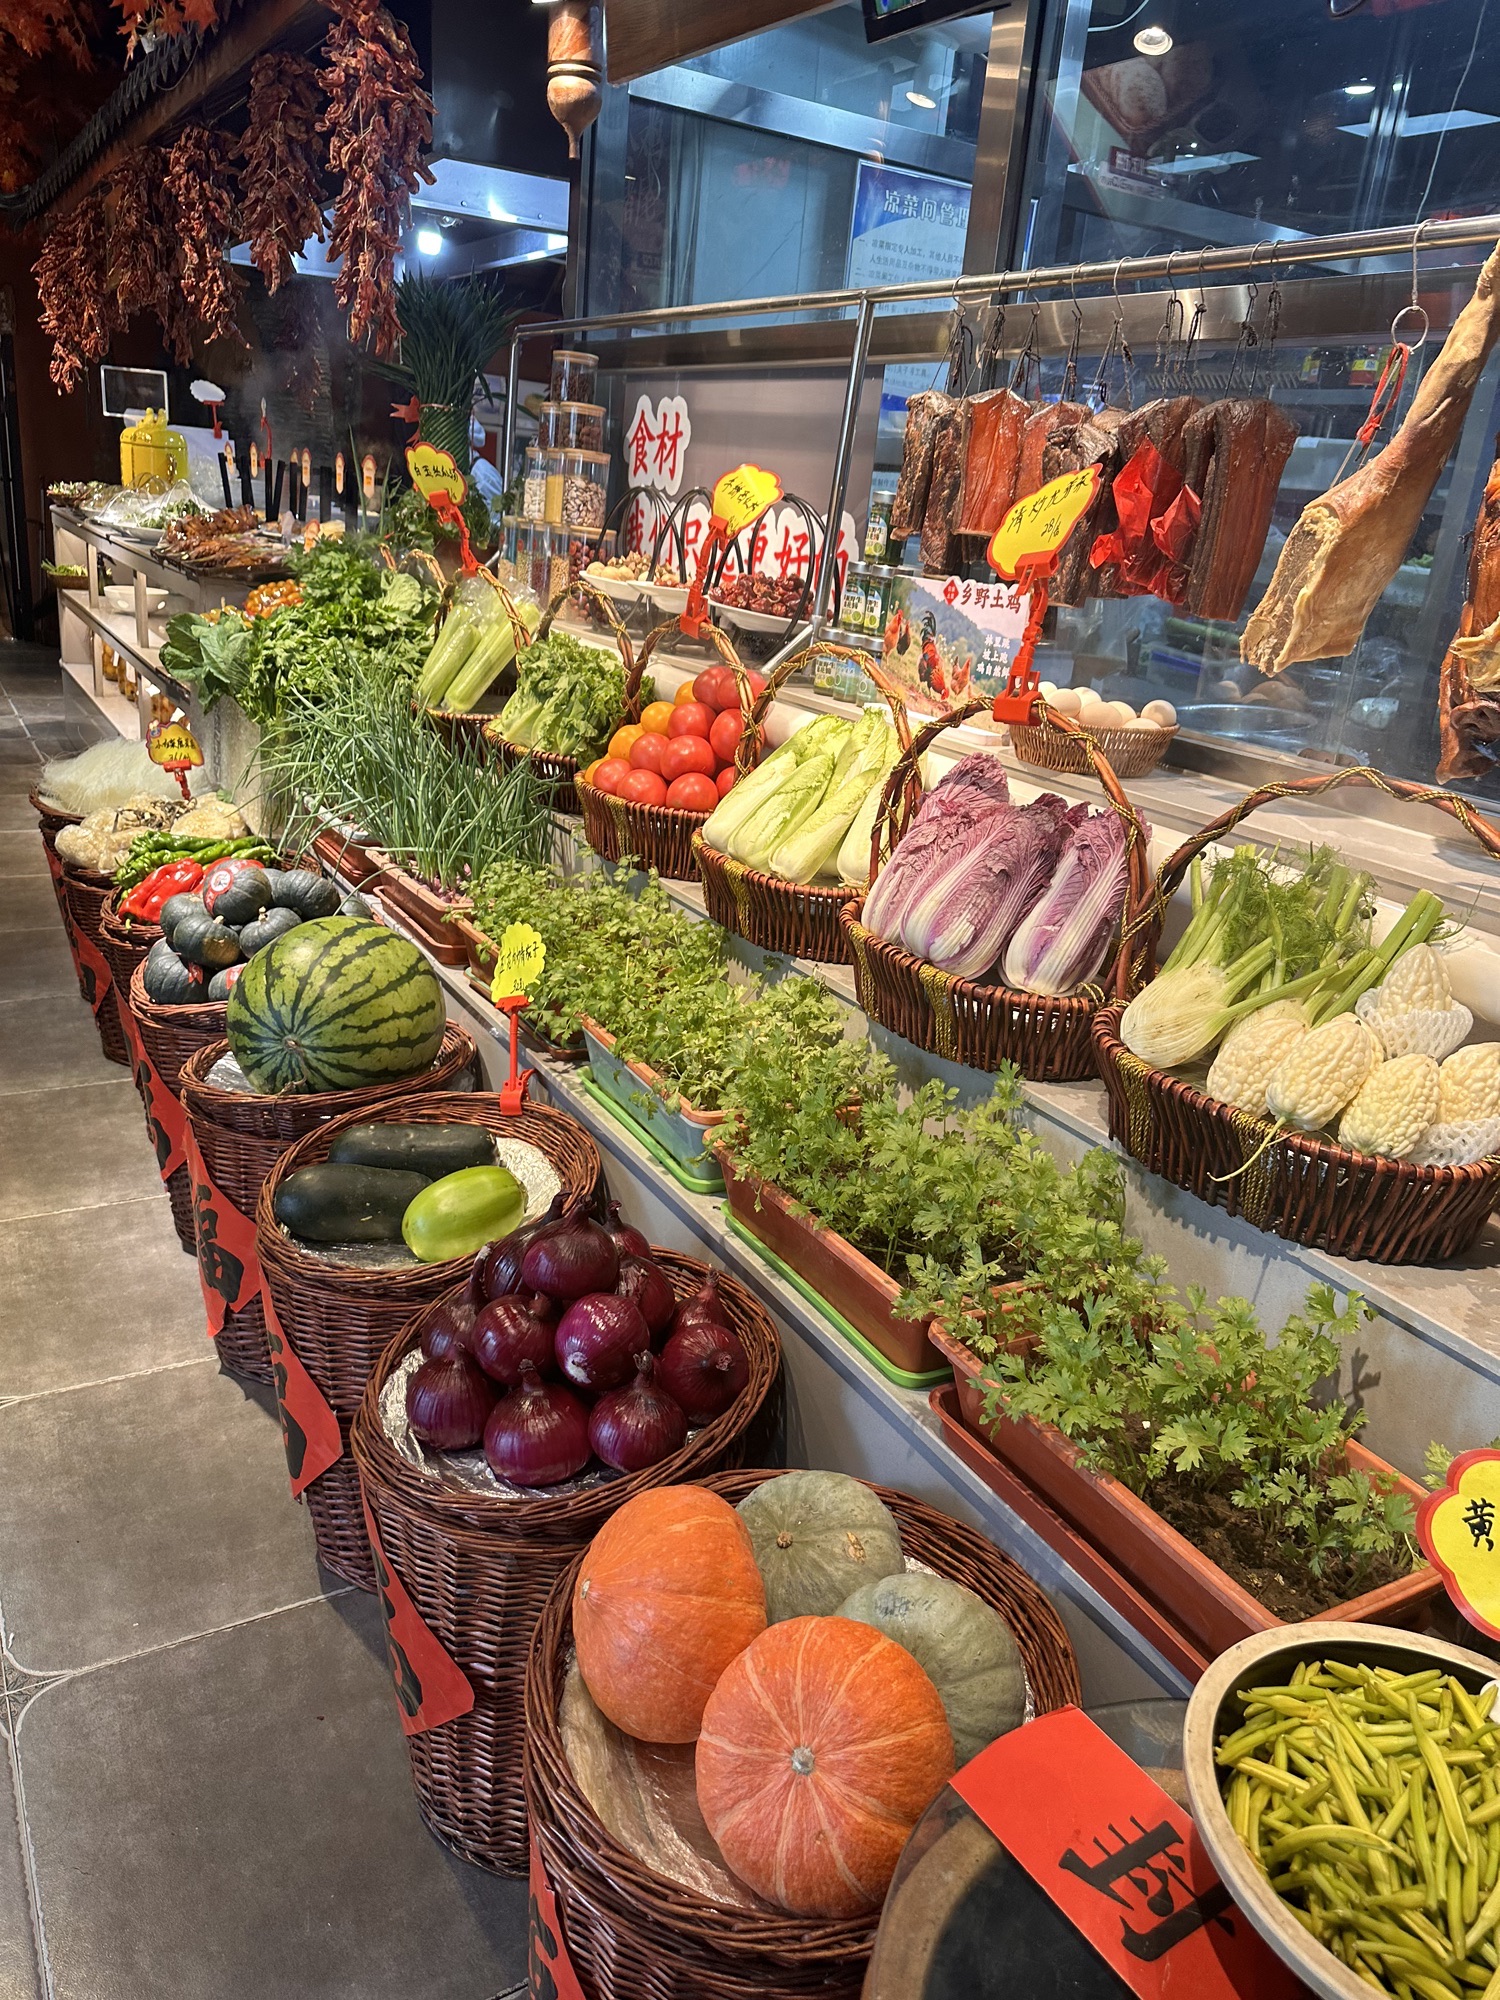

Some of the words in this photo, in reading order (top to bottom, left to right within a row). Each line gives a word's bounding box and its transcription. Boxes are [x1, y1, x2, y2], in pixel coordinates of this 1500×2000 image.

[628, 409, 683, 480] 食材
[961, 583, 1021, 614] 乡野土鸡
[976, 661, 1011, 679] 鸡自然鲜
[1462, 1497, 1496, 1551] 黄
